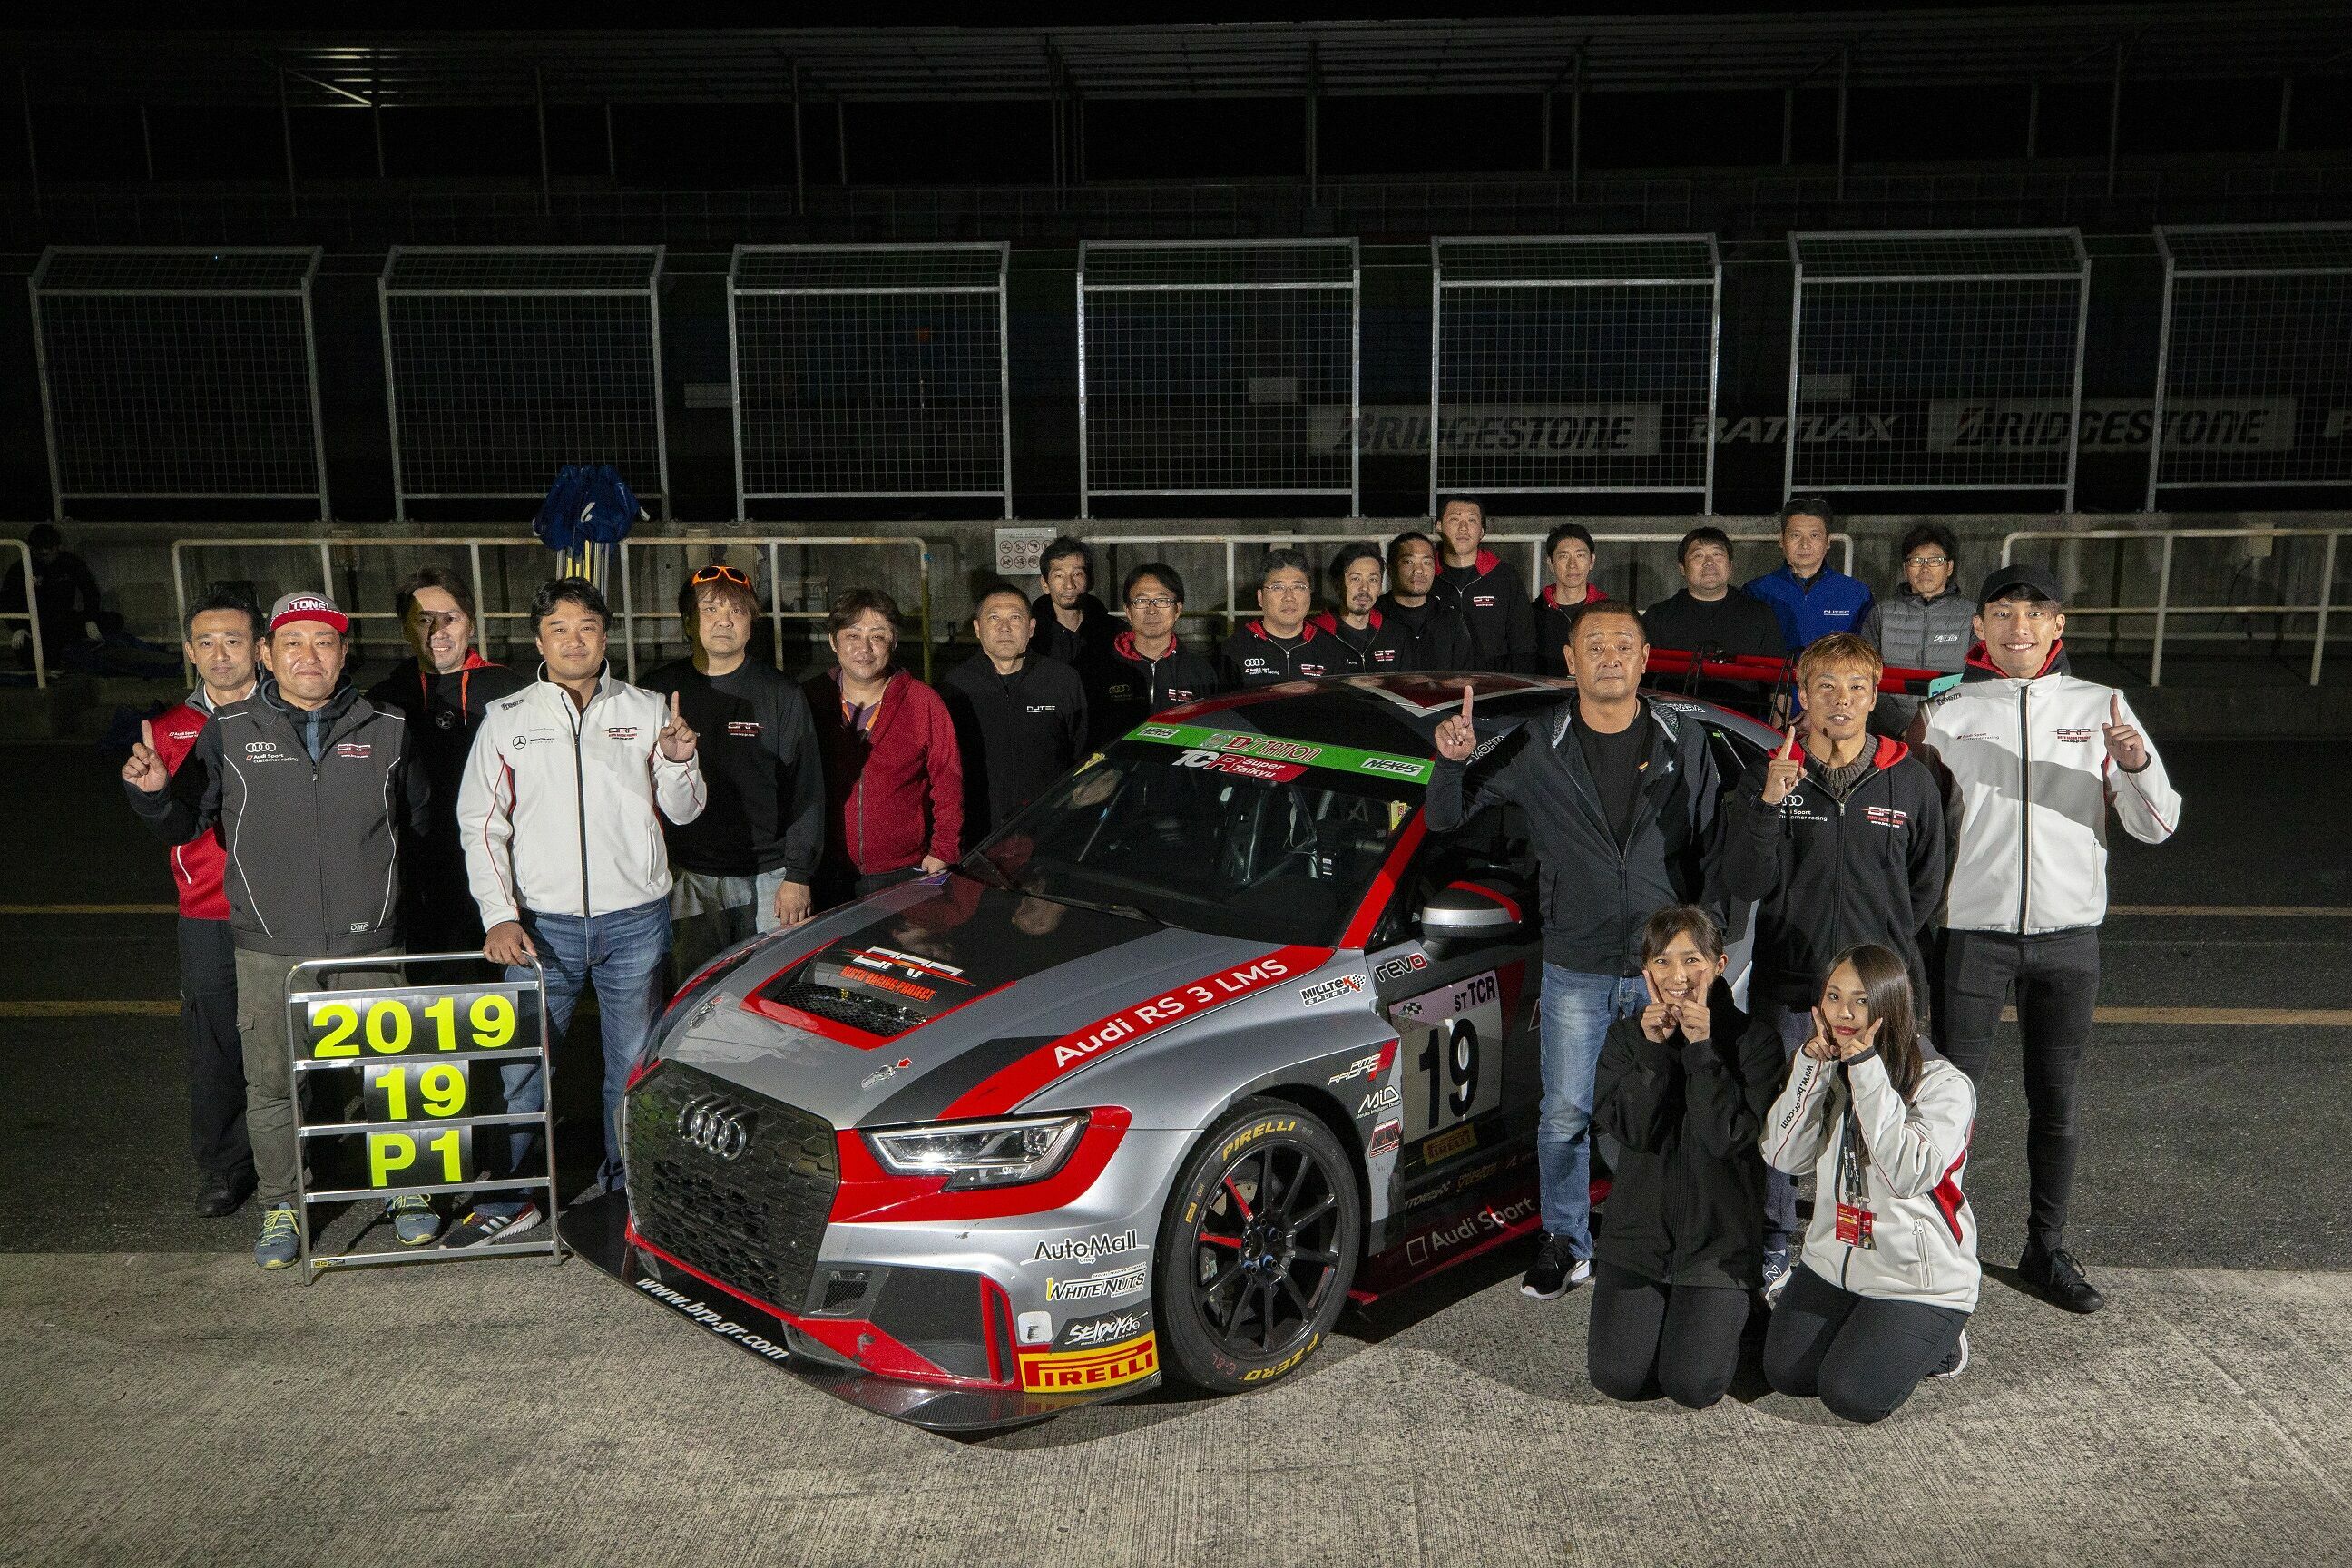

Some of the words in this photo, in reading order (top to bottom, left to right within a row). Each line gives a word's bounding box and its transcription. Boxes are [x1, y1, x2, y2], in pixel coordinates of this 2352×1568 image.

[1333, 412, 1634, 451] BRIDGESTONE
[1953, 408, 2267, 446] BRIDGESTONE
[291, 600, 326, 610] TONE
[1172, 749, 1245, 771] TCR
[1233, 764, 1276, 778] Taikyu
[1242, 759, 1286, 769] Super
[1363, 760, 1420, 772] NEXUS
[838, 965, 863, 981] BIRTH
[865, 971, 896, 992] RACING
[897, 980, 937, 1002] PROJECT
[1307, 987, 1348, 1005] SPORT
[1467, 976, 1496, 1005] TCR
[312, 995, 515, 1057] 2019
[1054, 1018, 1134, 1068] Audi
[1140, 997, 1185, 1024] RS
[1187, 986, 1213, 1006] 3
[1216, 959, 1288, 994] LMS
[1419, 1018, 1479, 1131] 19
[375, 1064, 466, 1120] 19
[1222, 1121, 1295, 1161] PIRELLI
[1427, 1129, 1471, 1158] PIRELLI
[370, 1130, 462, 1187] P1
[1432, 1217, 1478, 1250] Audi
[1478, 1197, 1536, 1229] Sport
[1034, 1230, 1137, 1260] AutoMall
[1046, 1278, 1101, 1300] WHITE
[1102, 1272, 1145, 1295] NUTS
[1024, 1340, 1153, 1386] PIRELLI
[1244, 1353, 1307, 1381] ZERO
